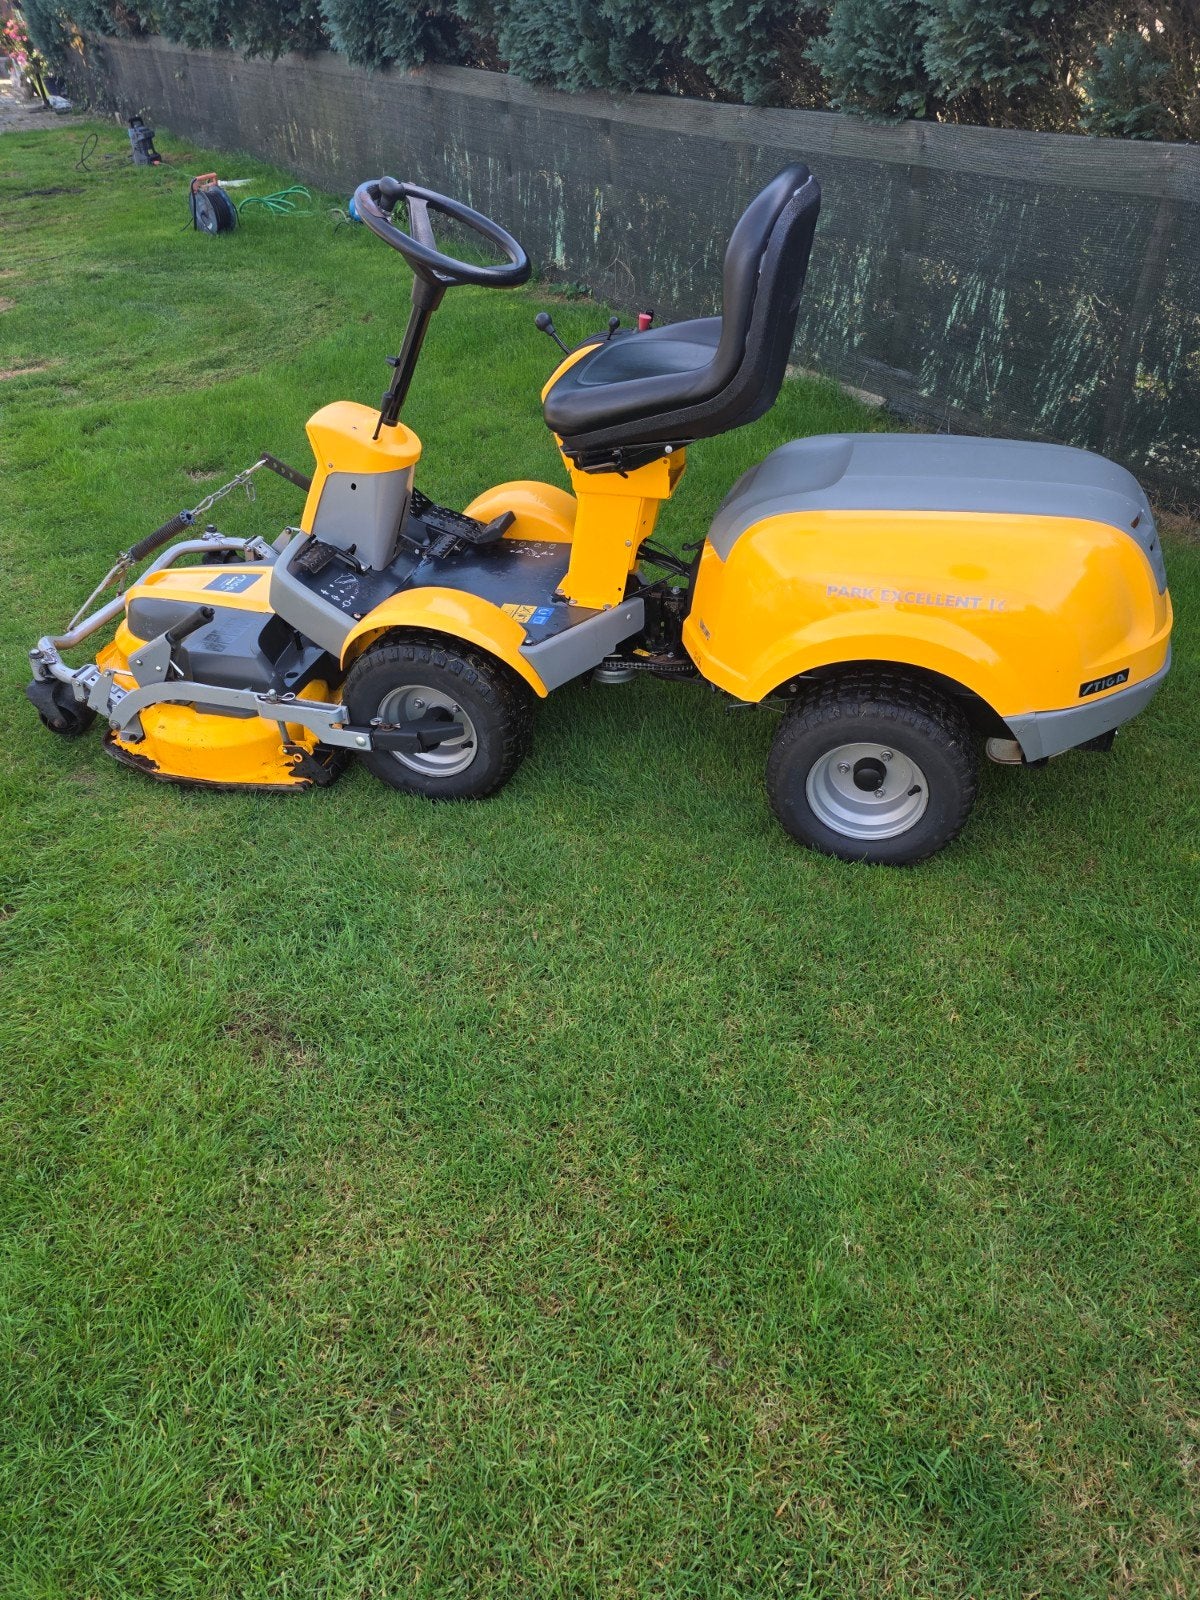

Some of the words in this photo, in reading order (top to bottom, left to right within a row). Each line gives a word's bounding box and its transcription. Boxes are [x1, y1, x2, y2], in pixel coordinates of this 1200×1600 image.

[826, 585, 875, 600] PARK
[880, 589, 982, 609] EXCELLENT
[1082, 673, 1127, 696] STIGA
